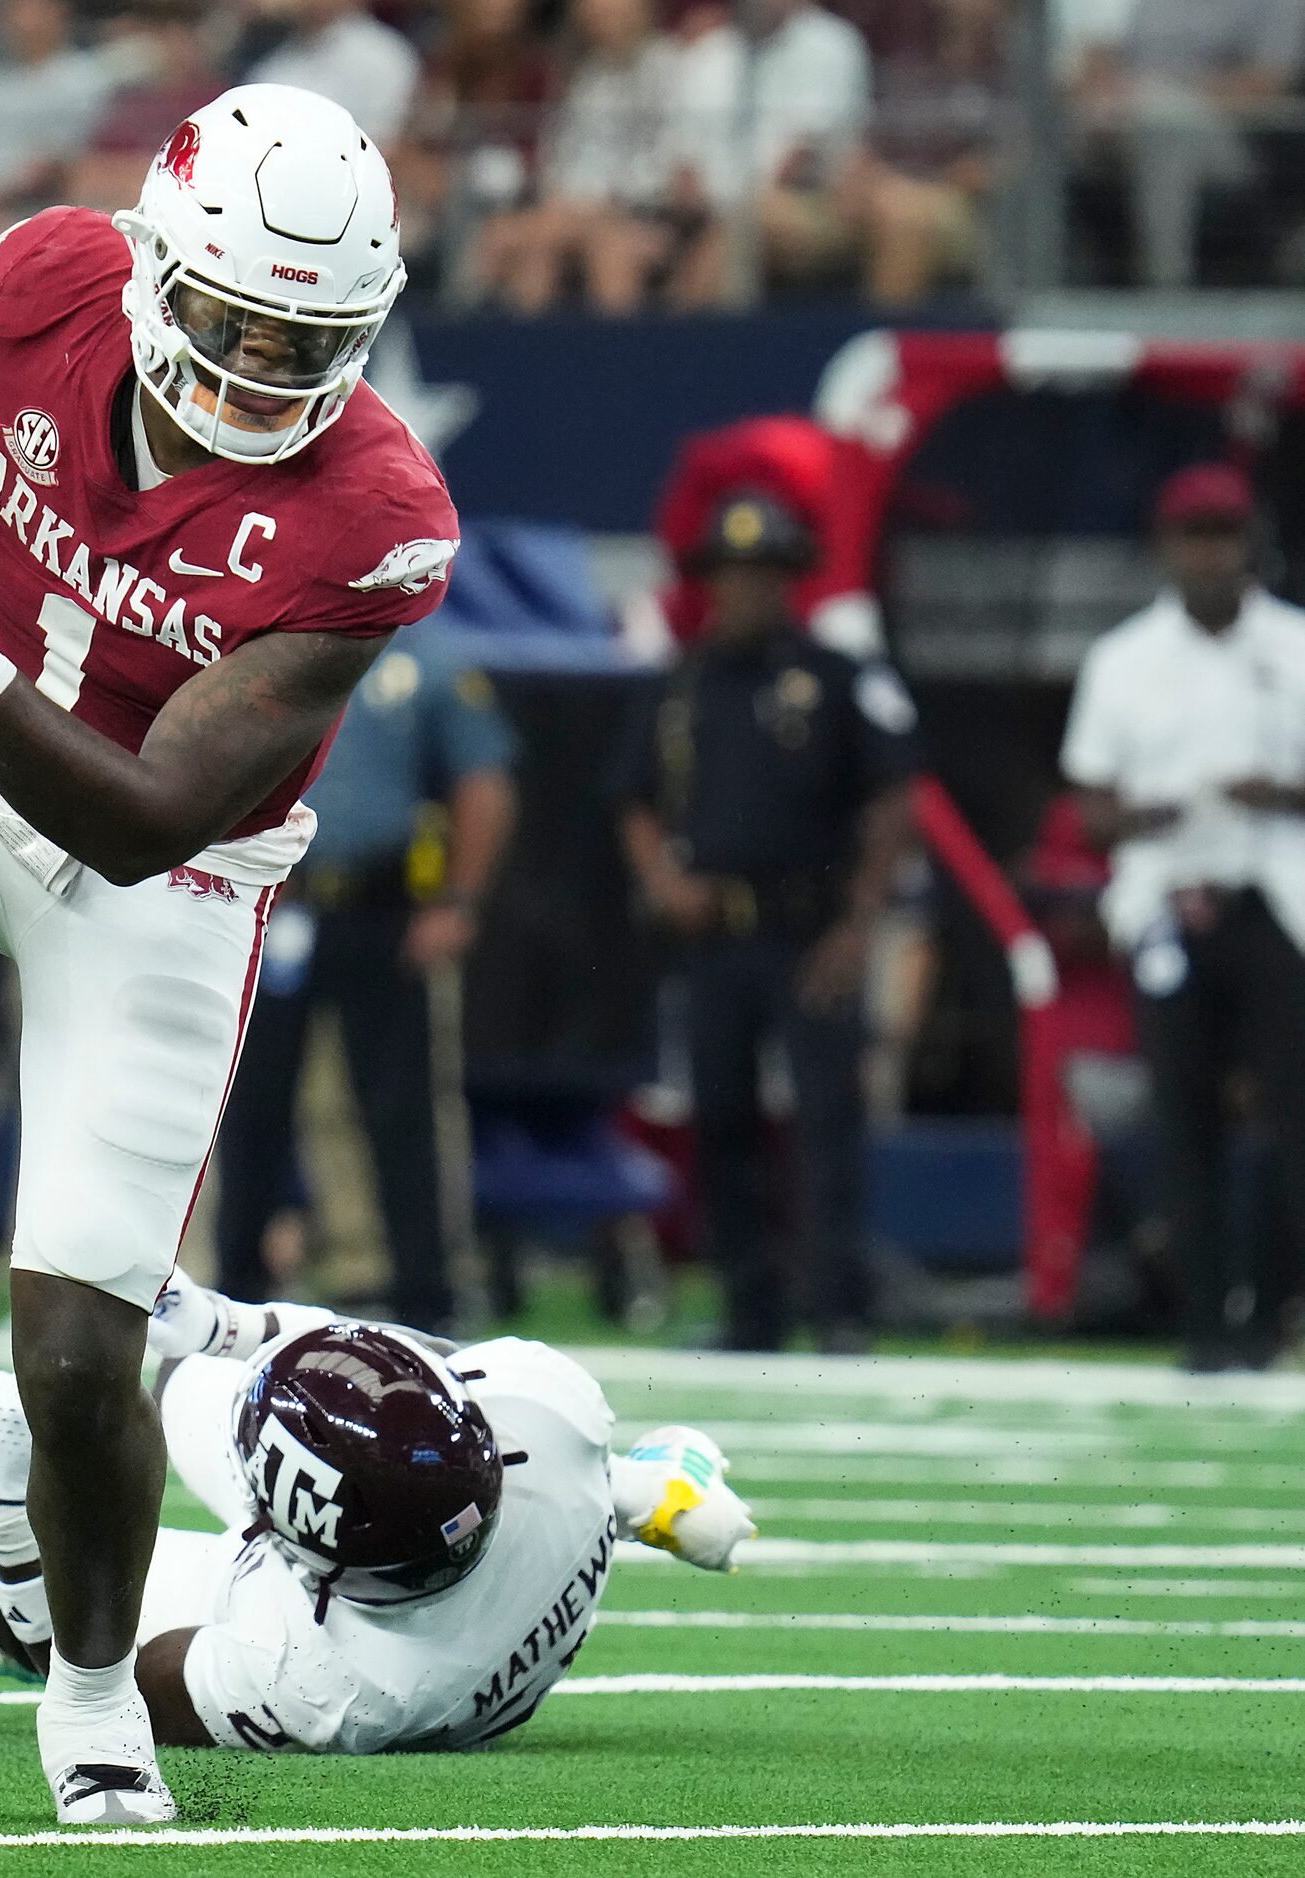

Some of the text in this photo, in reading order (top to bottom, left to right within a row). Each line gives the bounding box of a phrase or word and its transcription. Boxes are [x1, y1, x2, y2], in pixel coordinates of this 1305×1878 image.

[204, 242, 226, 260] NIKE
[270, 264, 319, 286] HOGS
[7, 440, 47, 483] GRADUATE
[17, 413, 56, 464] SEC
[227, 511, 277, 584] C
[35, 592, 97, 713] 1
